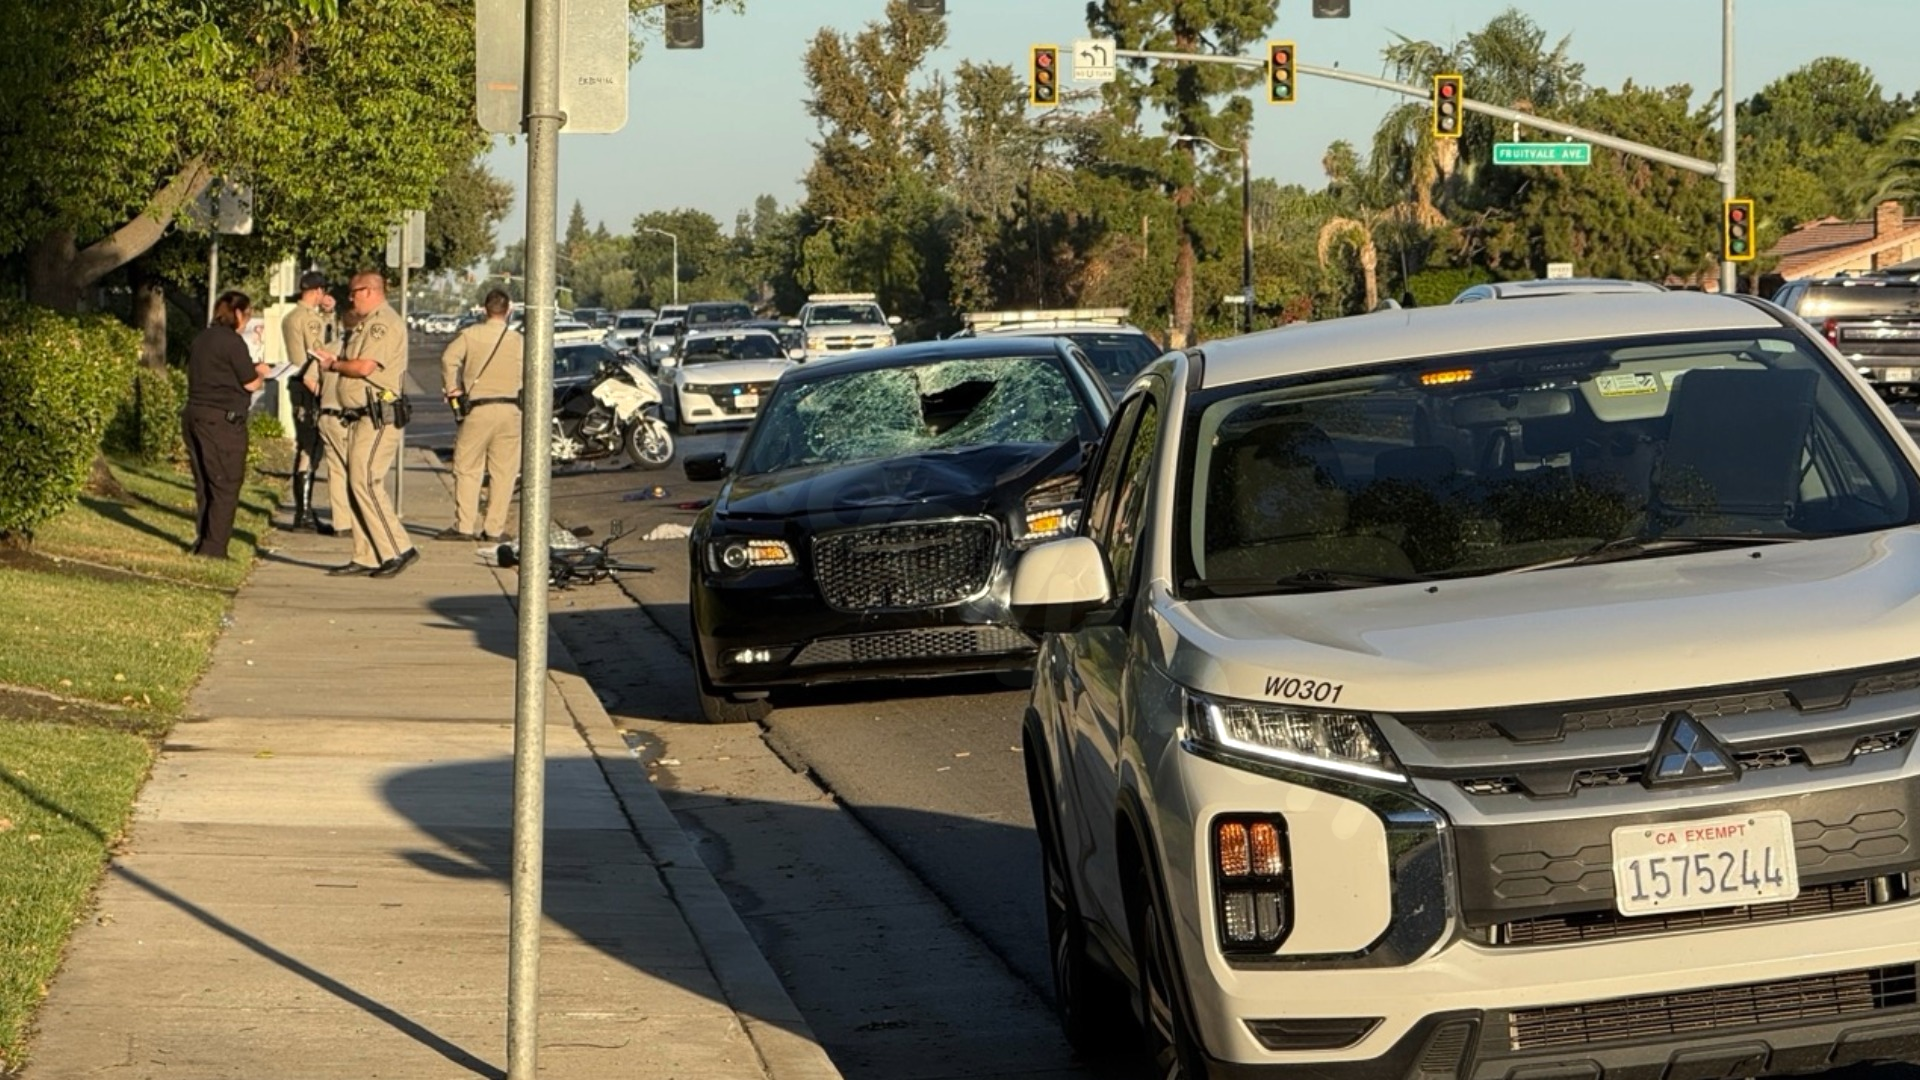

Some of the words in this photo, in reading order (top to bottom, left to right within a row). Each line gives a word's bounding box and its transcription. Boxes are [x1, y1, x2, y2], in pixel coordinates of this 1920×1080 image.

[1086, 69, 1094, 78] U
[1500, 149, 1556, 159] FRUITVALE
[1655, 831, 1677, 845] CA
[1685, 824, 1747, 842] EXEMPT
[1629, 846, 1783, 902] 1575244
